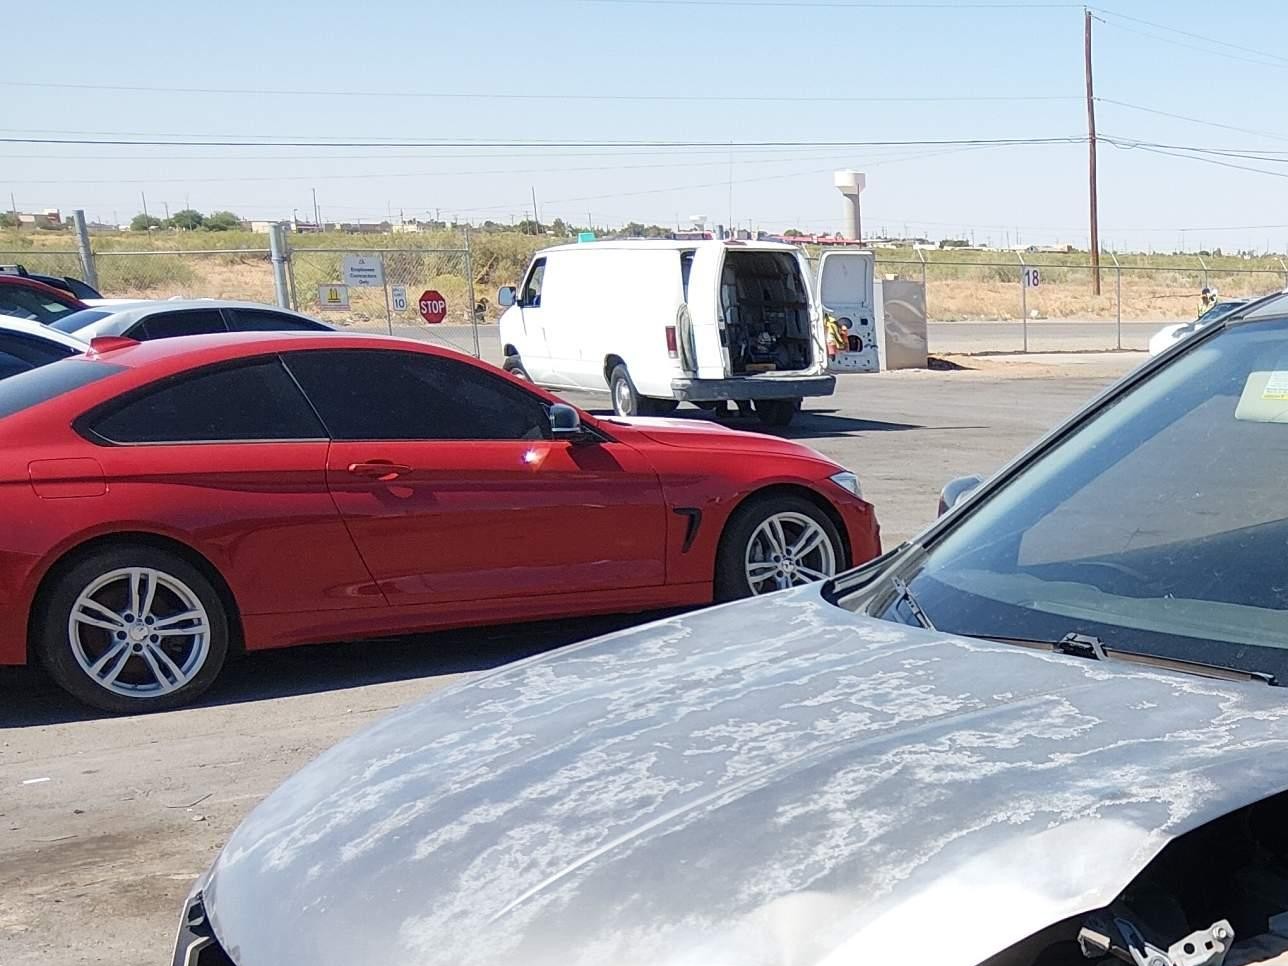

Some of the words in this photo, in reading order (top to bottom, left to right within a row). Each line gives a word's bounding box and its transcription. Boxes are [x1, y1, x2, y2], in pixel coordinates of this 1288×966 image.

[1024, 269, 1040, 287] 18
[394, 298, 405, 309] 10
[420, 300, 445, 314] STOP
